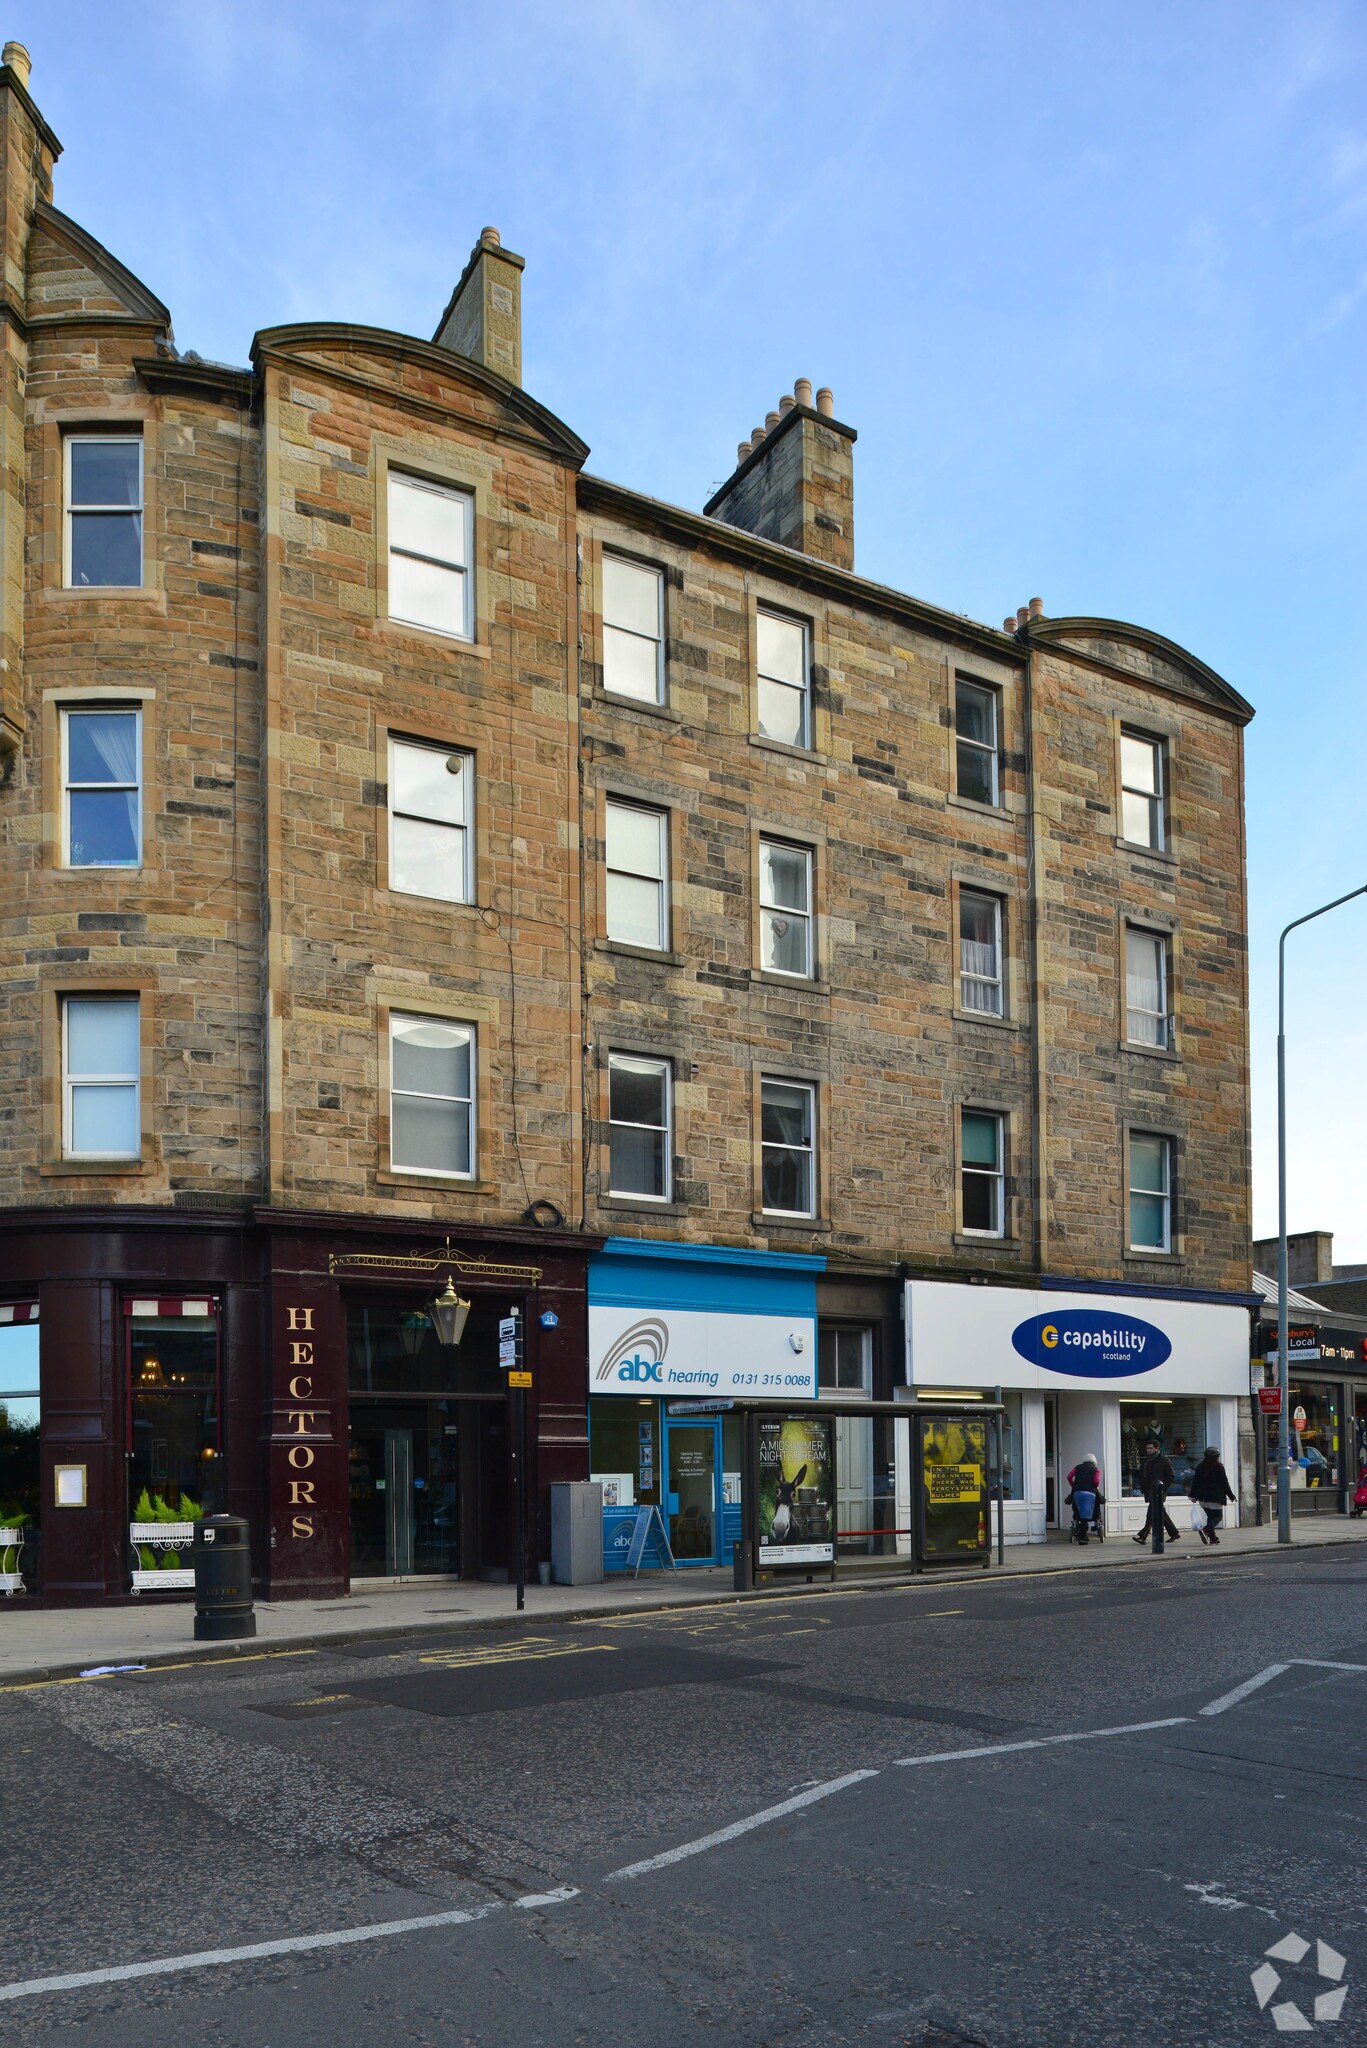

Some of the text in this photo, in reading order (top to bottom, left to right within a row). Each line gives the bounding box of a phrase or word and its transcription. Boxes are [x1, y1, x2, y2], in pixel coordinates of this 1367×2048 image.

[1063, 1329, 1146, 1353] capability
[1290, 1337, 1315, 1347] Local
[1102, 1352, 1131, 1361] scotland
[1321, 1344, 1336, 1357] 7am
[1340, 1346, 1355, 1360] 11pm
[618, 1354, 811, 1387] abc hearing 0131 315 0088
[285, 1306, 317, 1539] HECTORS
[760, 1440, 823, 1451] A MIDSUMMER
[796, 1450, 826, 1461] DREAM
[206, 1586, 239, 1595] LITTER
